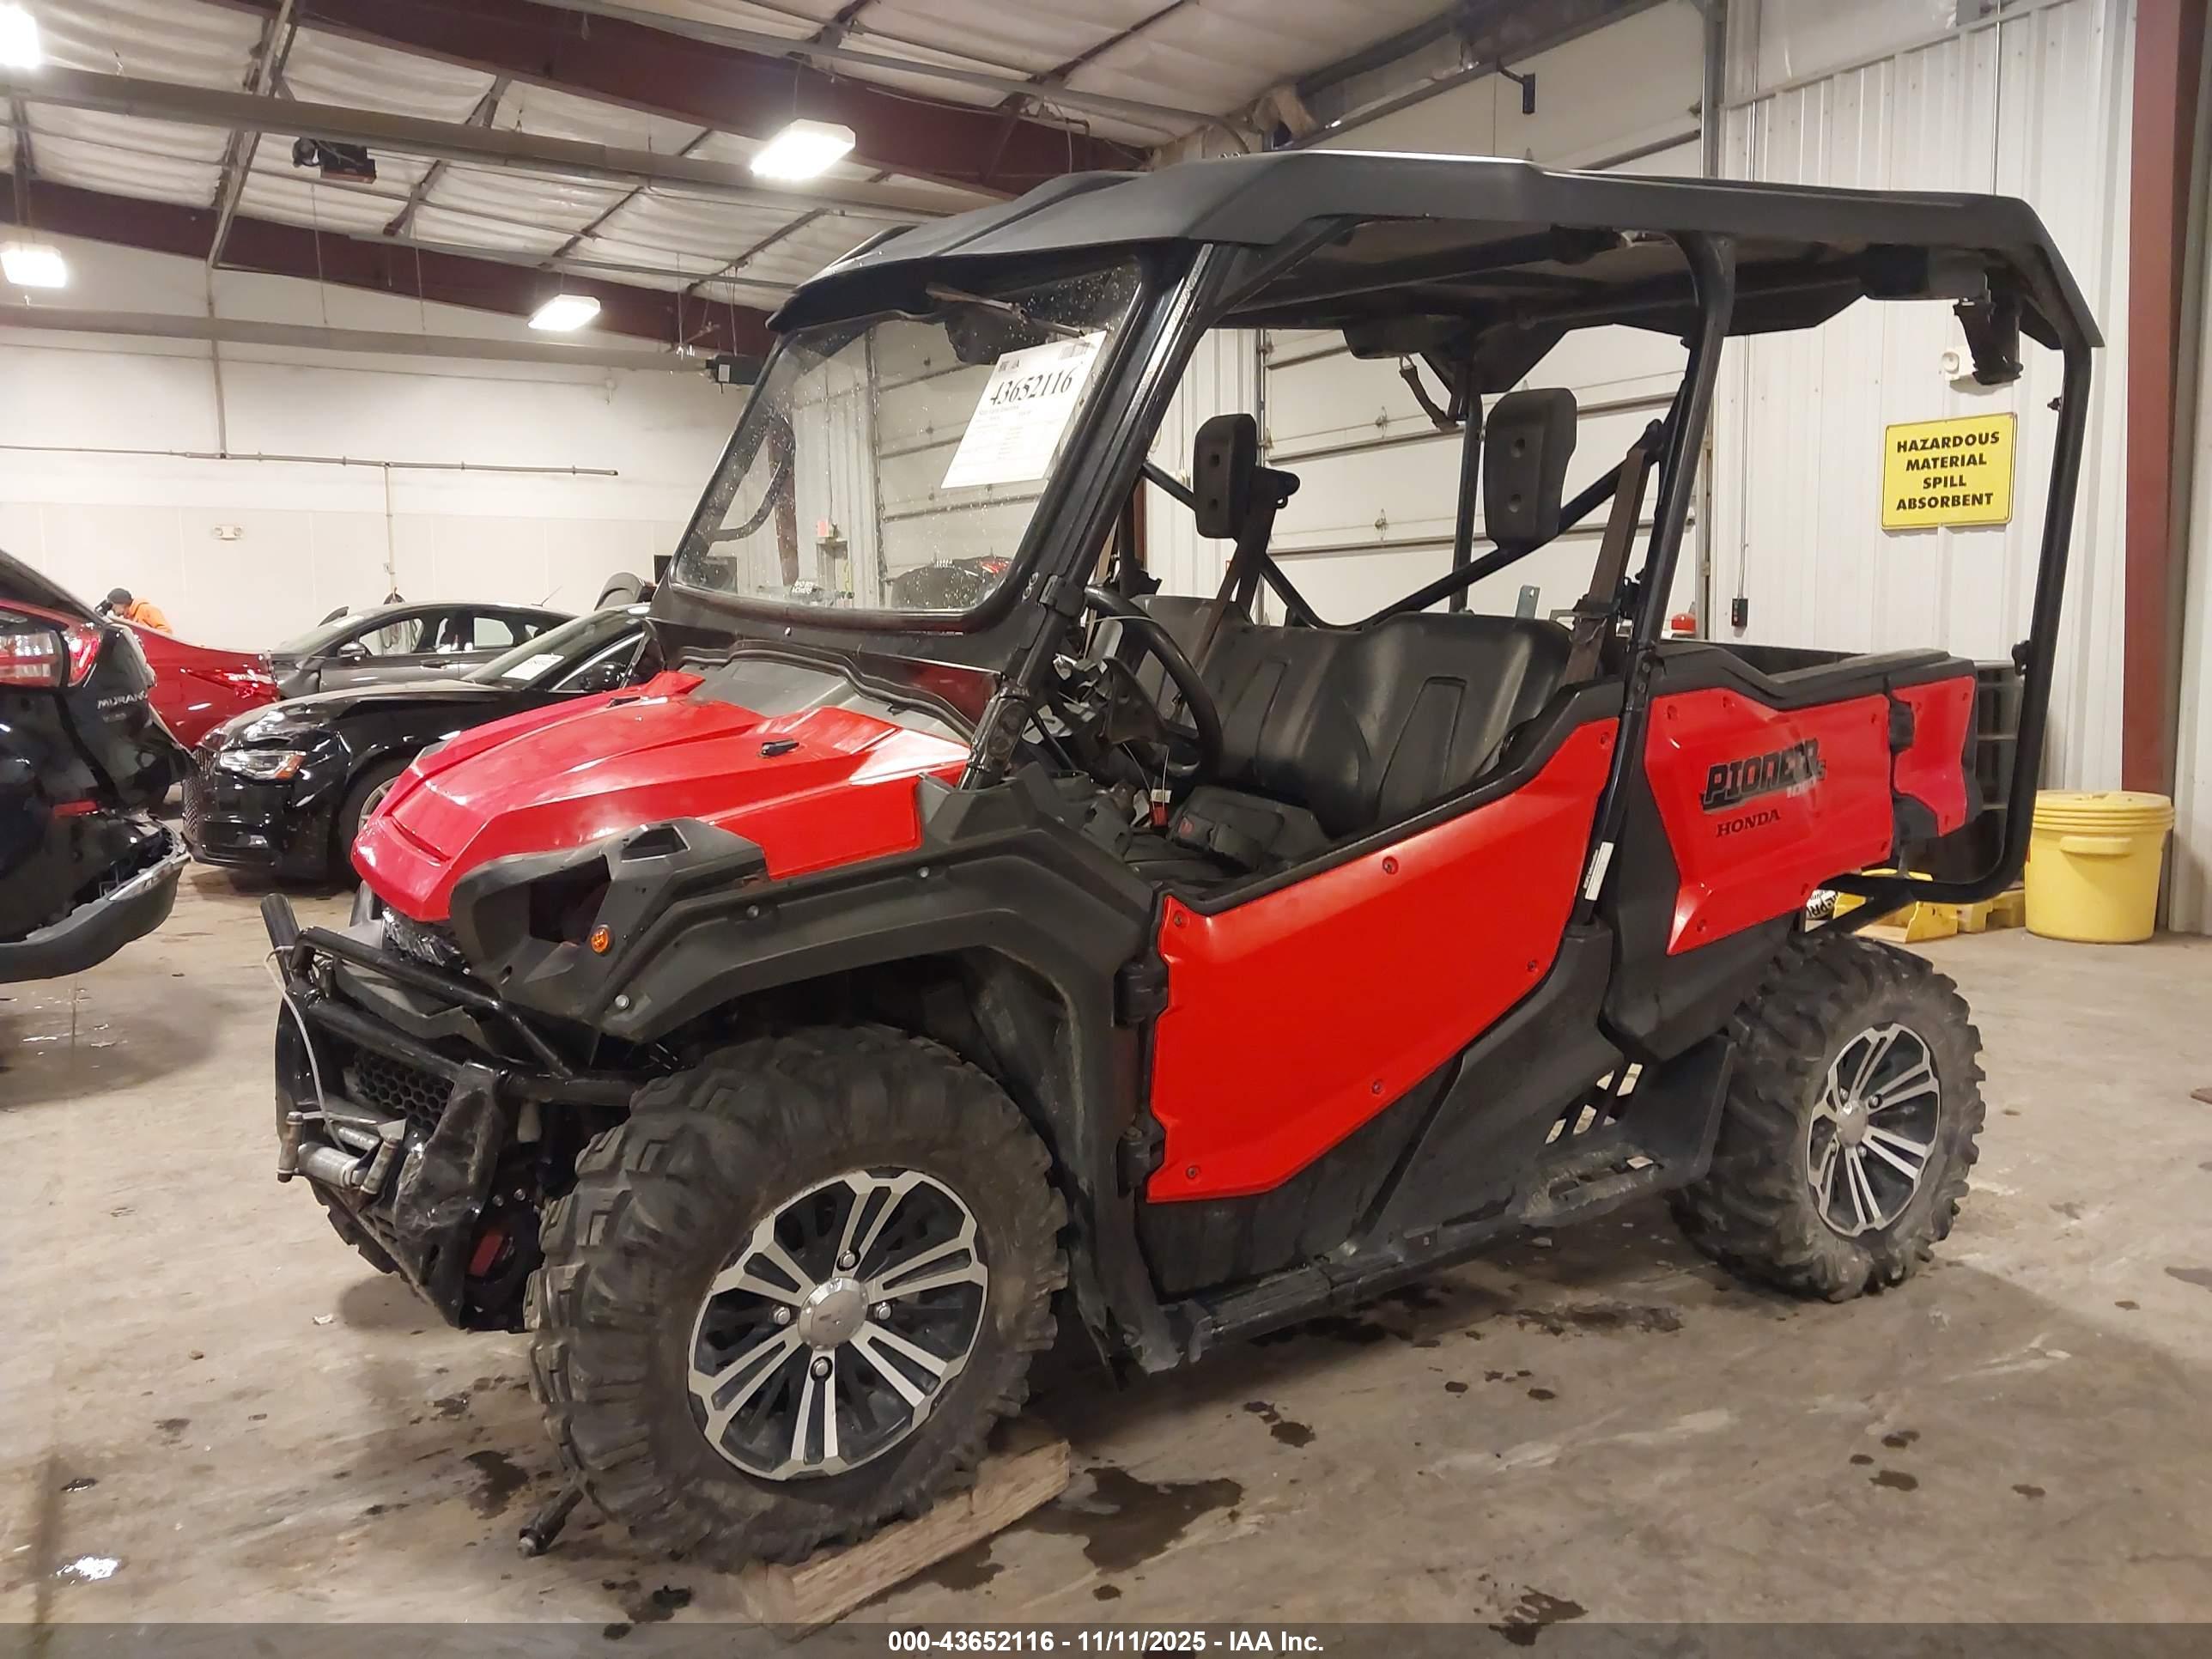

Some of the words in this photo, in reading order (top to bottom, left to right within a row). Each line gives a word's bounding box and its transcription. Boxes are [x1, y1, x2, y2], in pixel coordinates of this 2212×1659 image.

[990, 366, 1079, 405] 43652116
[1897, 431, 2000, 453] HAZARDOUS
[1905, 453, 1987, 471] MATERIAL
[1923, 475, 1966, 489] SPILL
[1896, 493, 1994, 511] ABSORBENT
[1717, 809, 1781, 838] HONDA
